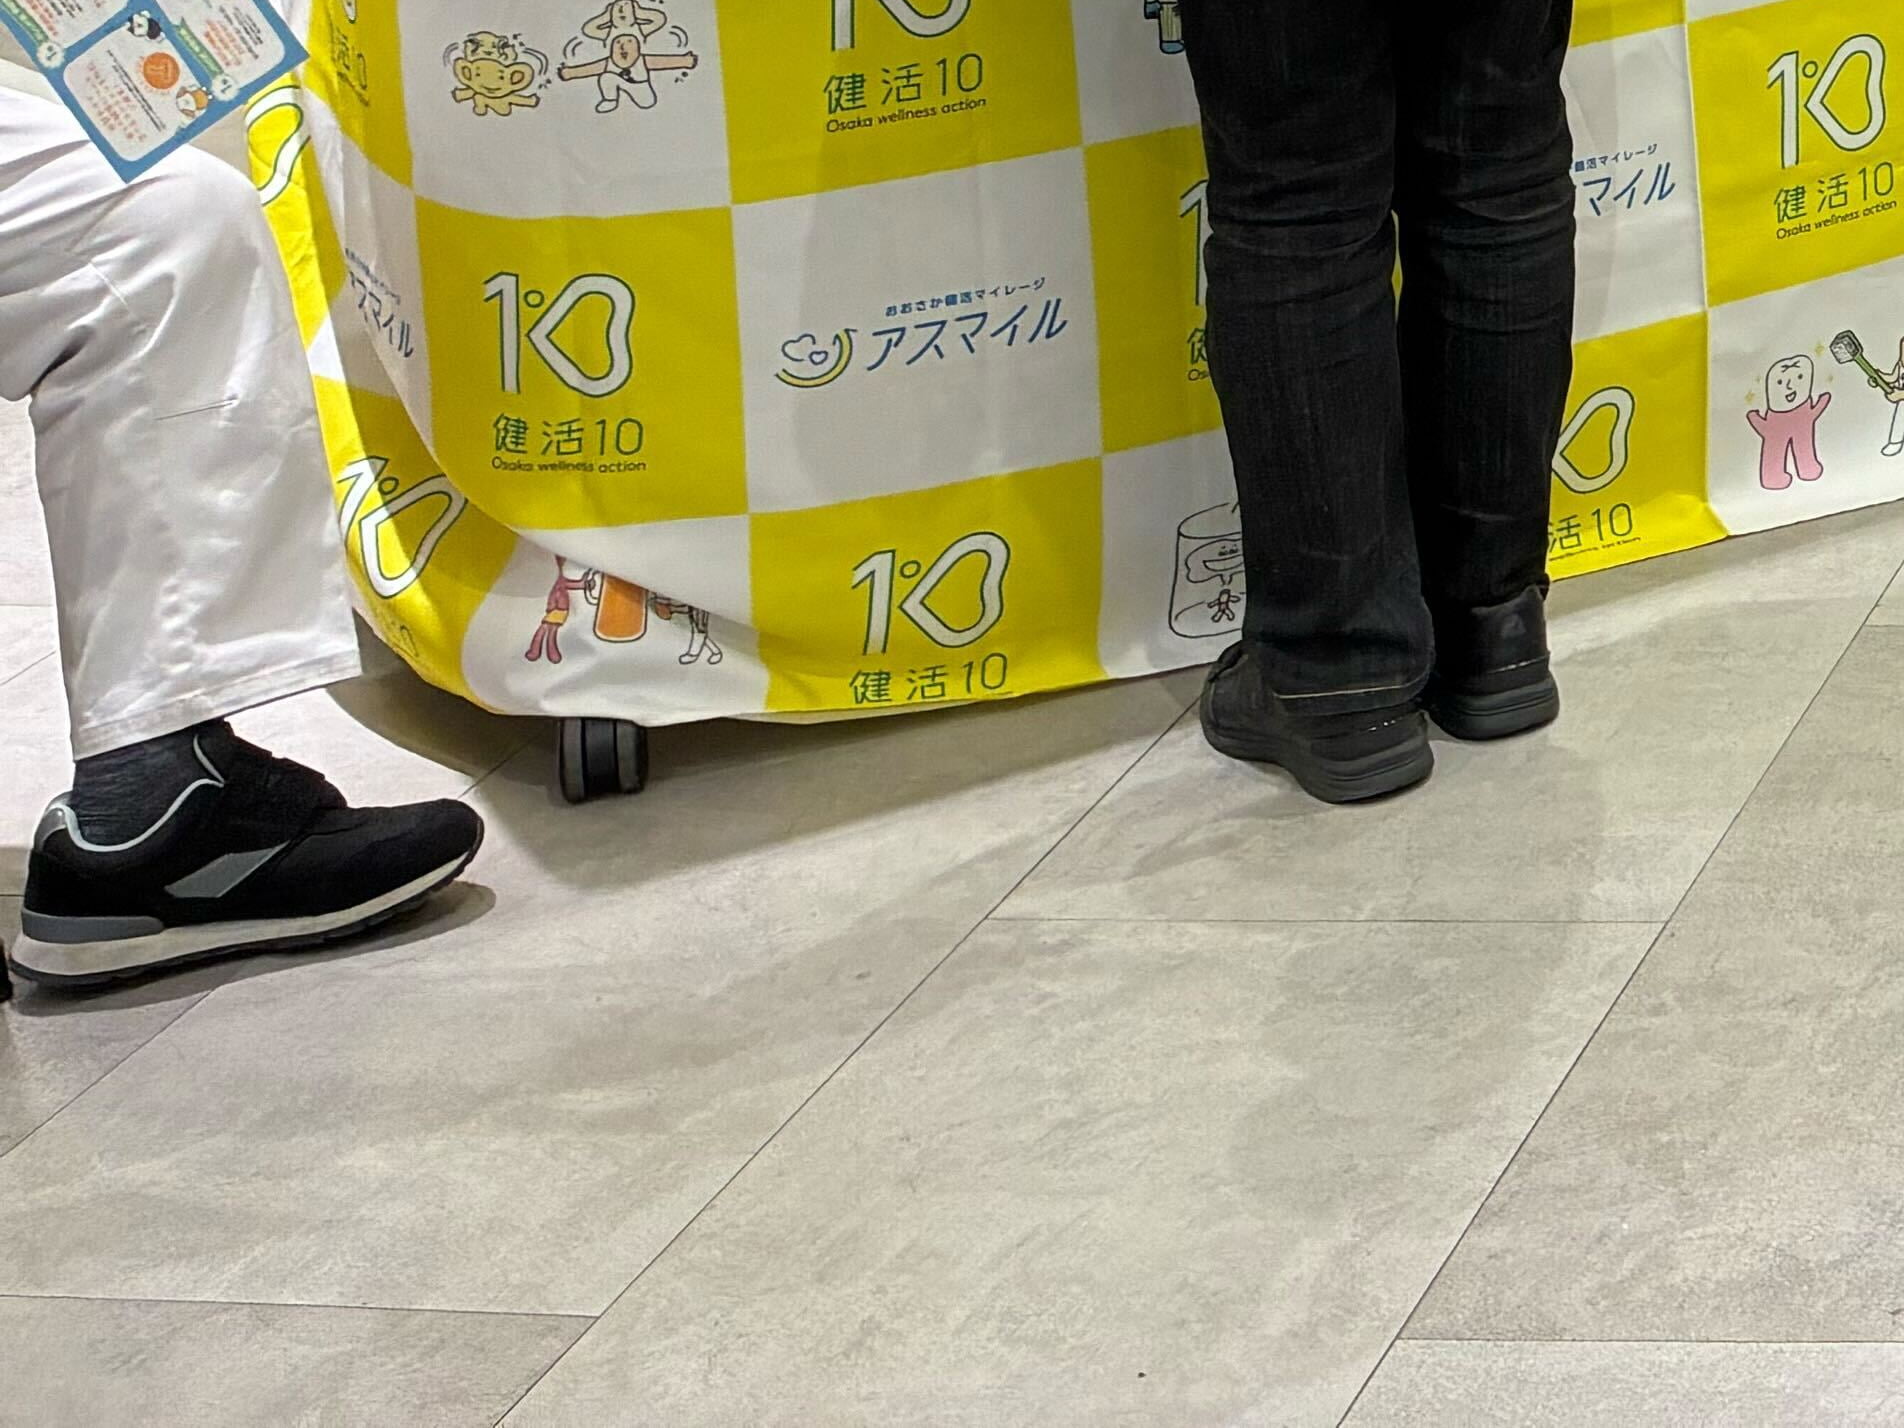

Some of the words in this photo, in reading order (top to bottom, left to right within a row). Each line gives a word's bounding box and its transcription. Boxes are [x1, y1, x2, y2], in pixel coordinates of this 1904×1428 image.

[824, 53, 984, 115] 健活10
[825, 117, 873, 134] Osaka
[878, 106, 937, 126] wellness
[942, 97, 987, 115] action
[1582, 162, 1677, 217] マイル
[1773, 160, 1895, 224] 健活10
[1776, 223, 1812, 240] Osaka
[1814, 211, 1860, 231] wellness
[1863, 198, 1897, 217] action
[884, 276, 1046, 318] おおさか健活マイレージ
[866, 297, 1068, 372] アスマイル
[493, 413, 644, 457] 健活10
[491, 456, 534, 472] Osaka
[537, 460, 594, 473] wellness
[598, 461, 647, 473] action
[1548, 501, 1634, 553] 活10
[849, 652, 1009, 706] 健活10
